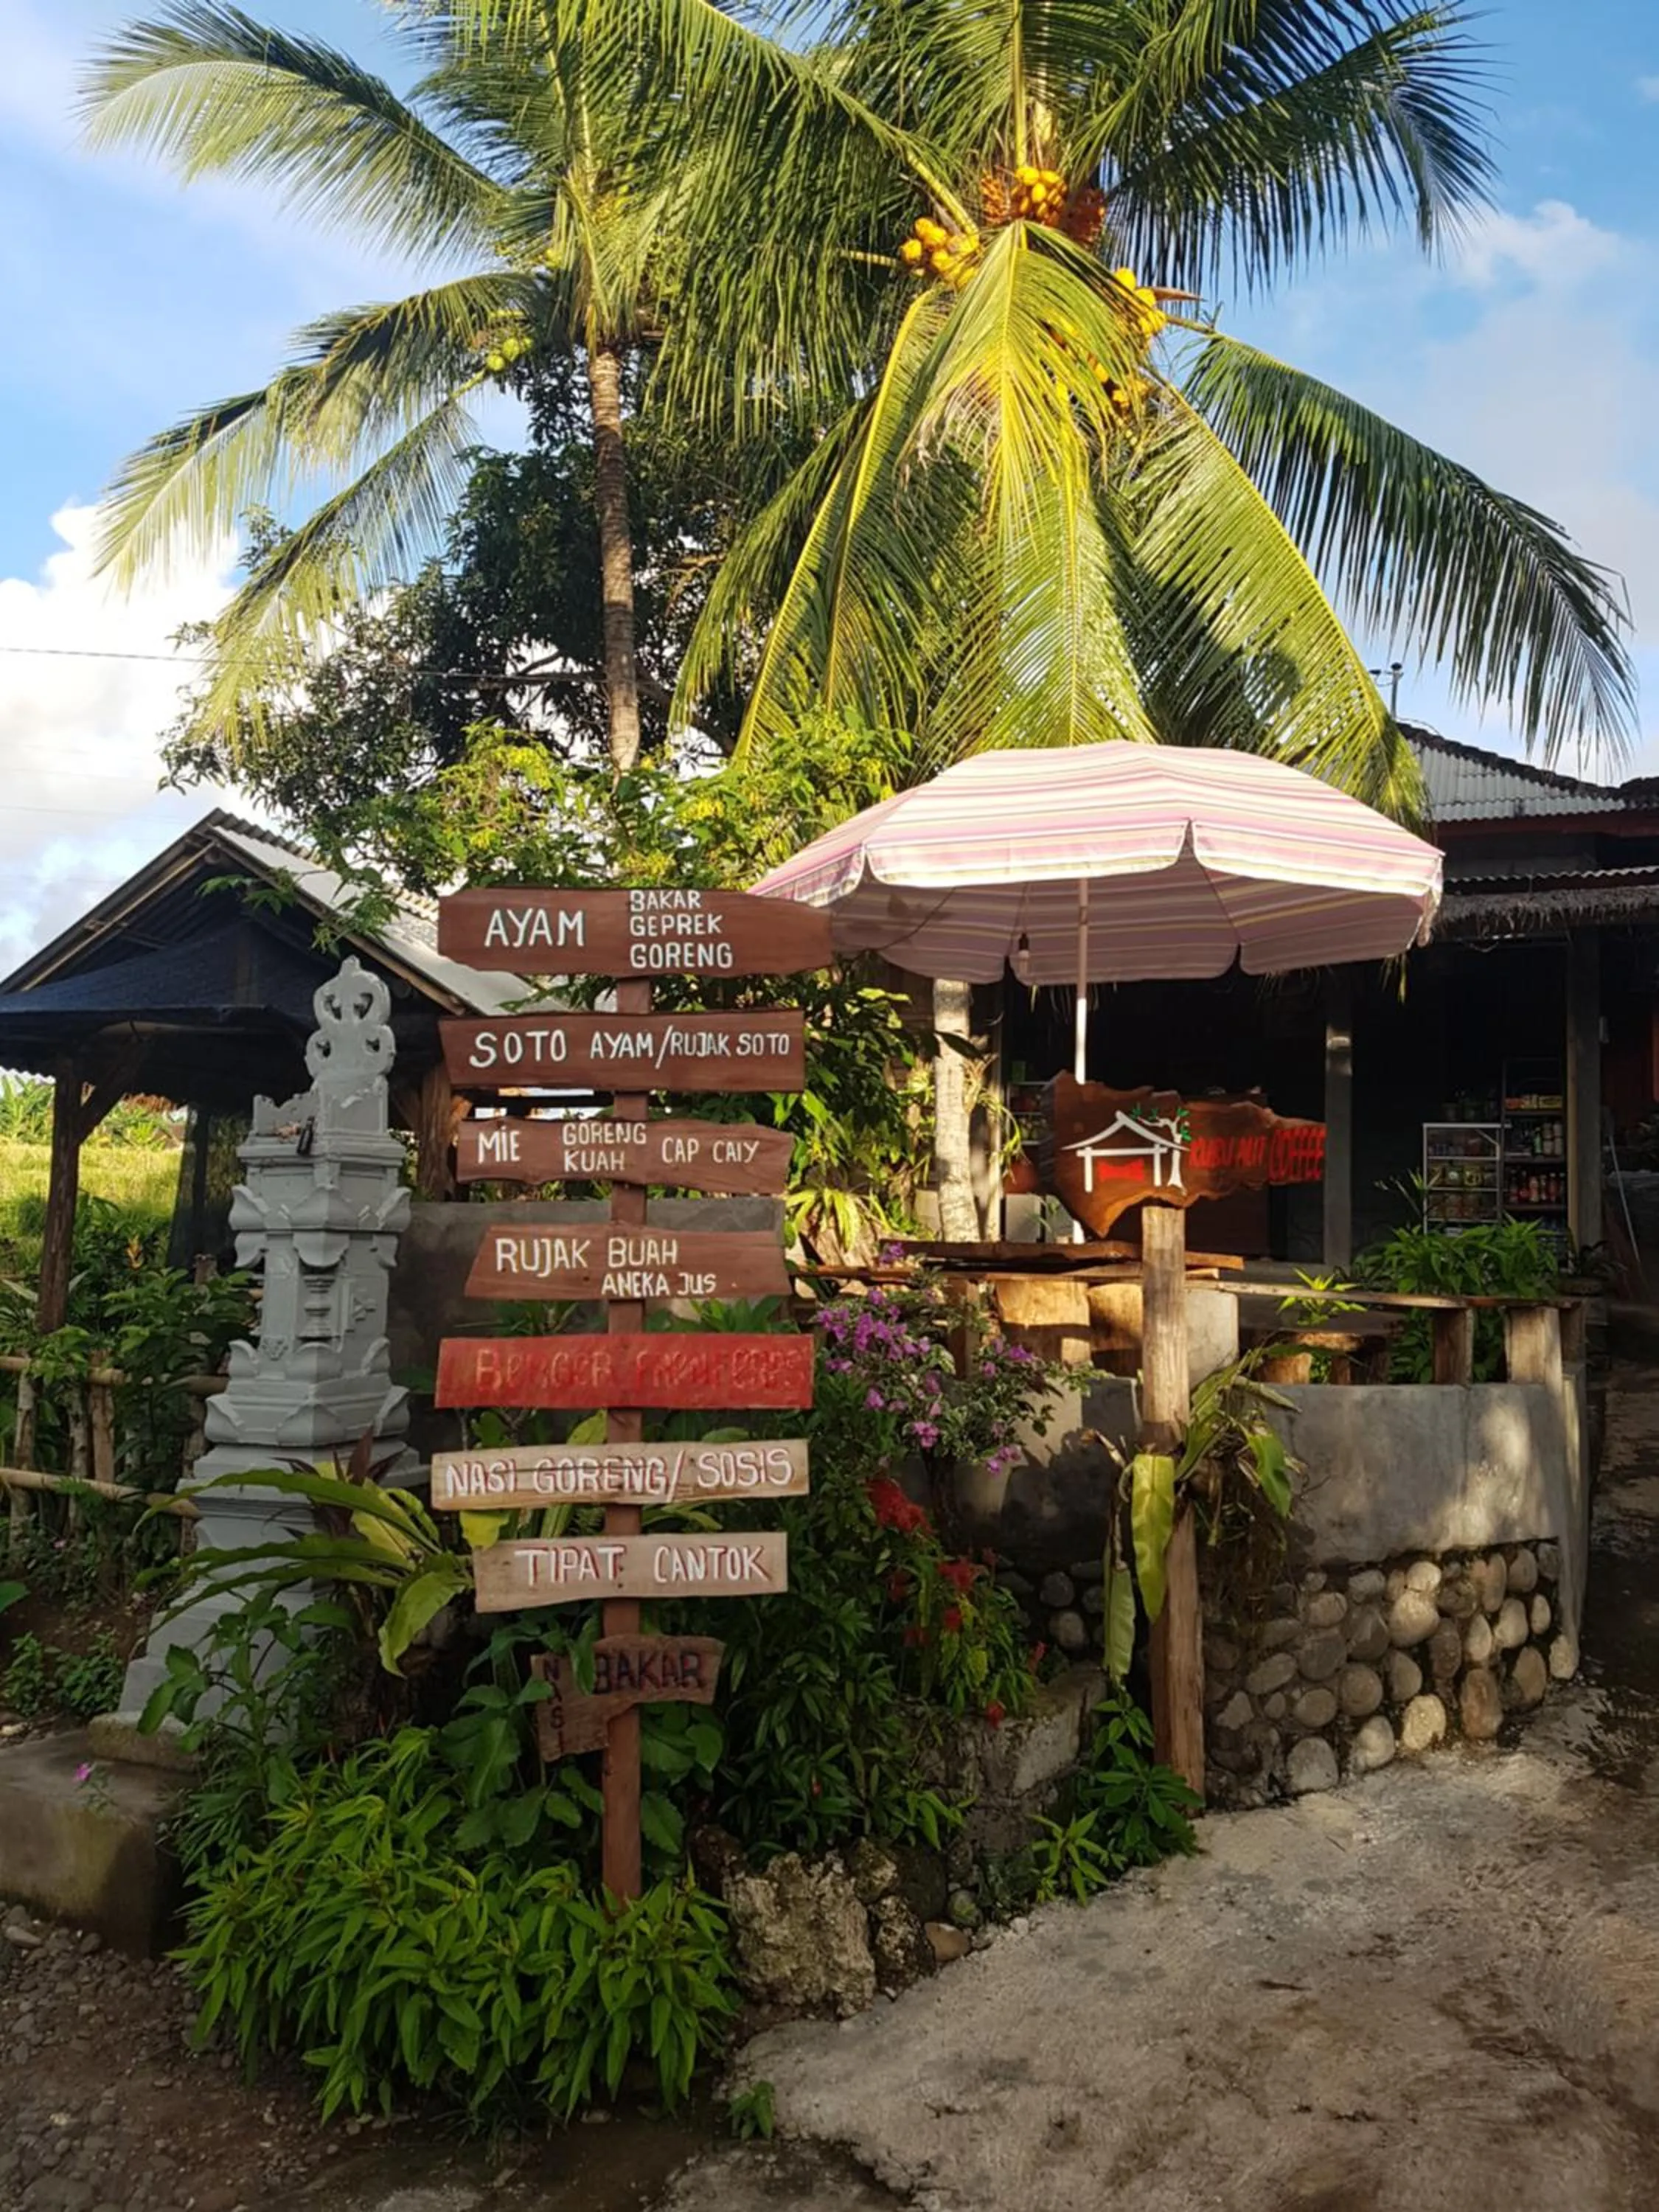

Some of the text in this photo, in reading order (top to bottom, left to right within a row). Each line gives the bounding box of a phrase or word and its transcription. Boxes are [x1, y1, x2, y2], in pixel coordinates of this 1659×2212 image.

[630, 889, 702, 913] BAKAR
[484, 907, 585, 947] AYAM
[630, 913, 723, 937] GEPREK
[630, 942, 734, 970] GORENG
[470, 1029, 567, 1068] SOTO
[736, 1032, 790, 1056] SOTO
[562, 1121, 647, 1146] GORENG
[564, 1149, 625, 1172] KUAH
[661, 1136, 700, 1164] CAP
[495, 1237, 678, 1278] RUJAK BUAH
[601, 1272, 669, 1297] ANEKA
[445, 1458, 516, 1499] NASI
[697, 1447, 792, 1489] SOSIS
[515, 1545, 773, 1586] TIPAT CANTOK
[594, 1650, 706, 1694] BAKAR
